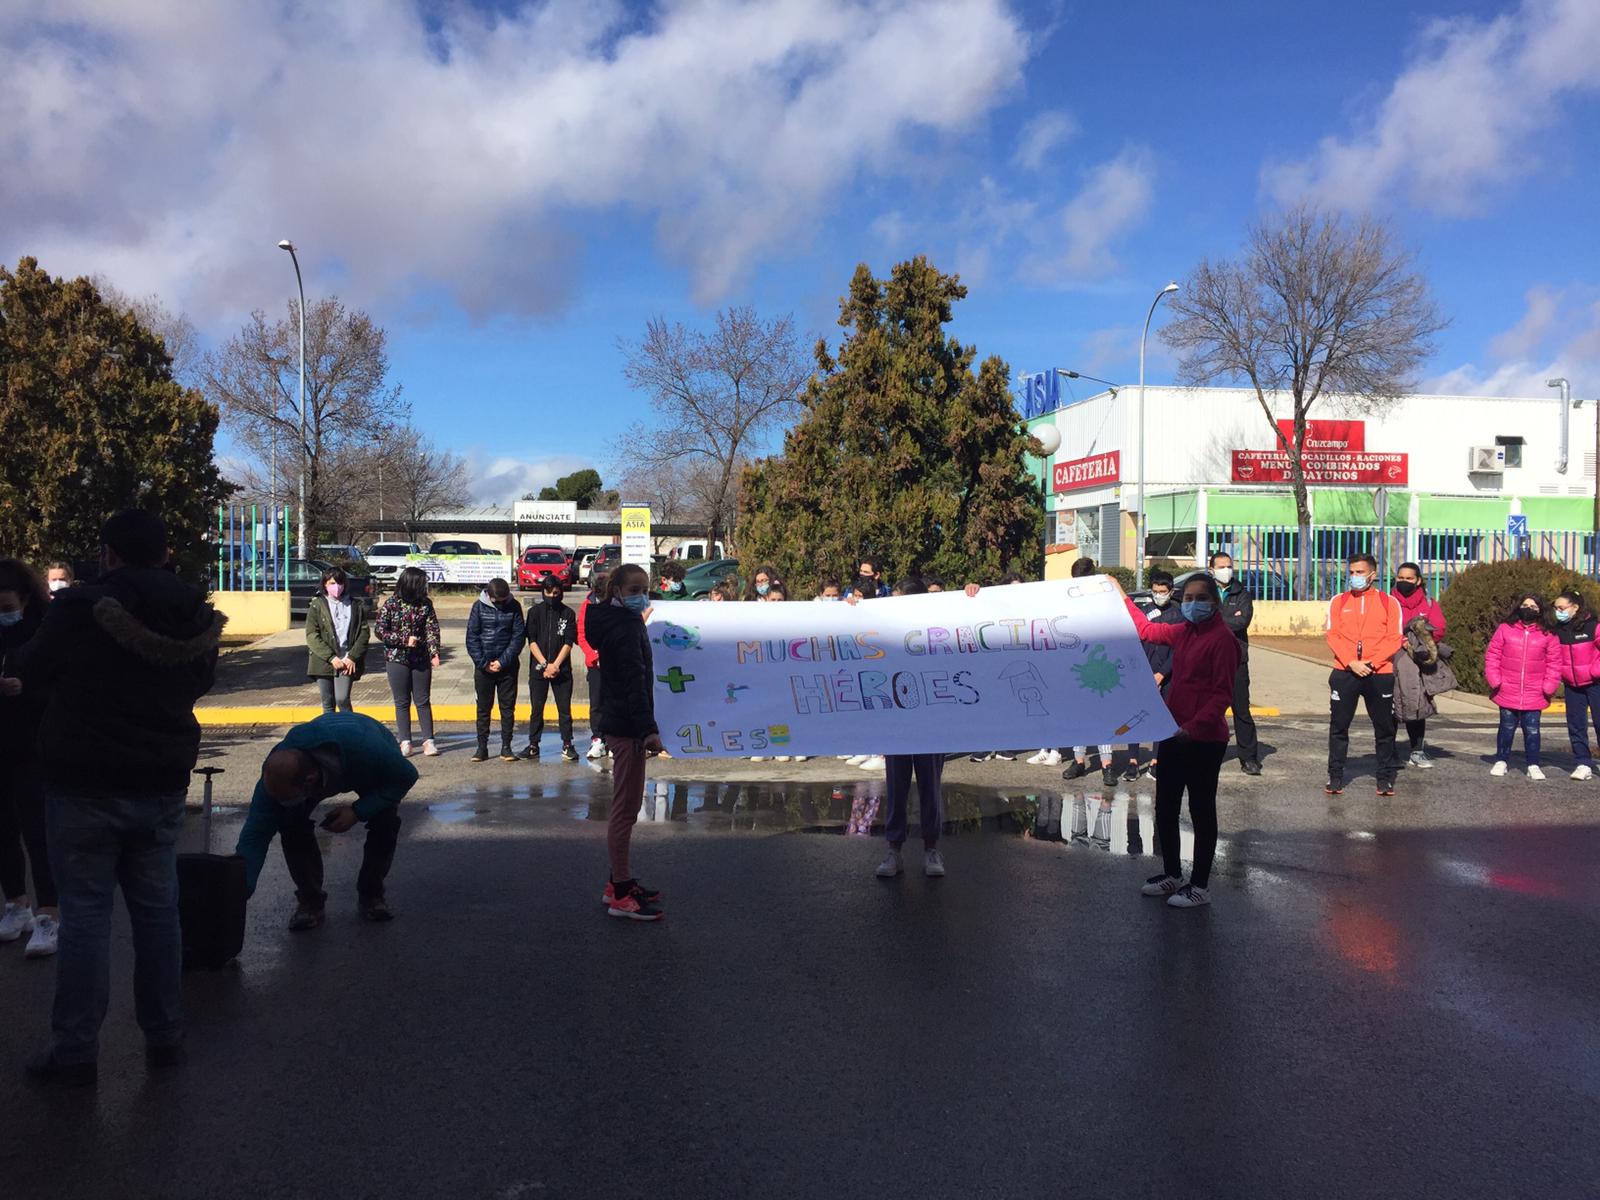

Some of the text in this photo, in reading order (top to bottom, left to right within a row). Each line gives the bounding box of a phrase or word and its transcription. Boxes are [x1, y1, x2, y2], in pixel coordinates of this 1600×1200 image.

[1306, 438, 1348, 450] Cruzcampo
[1055, 453, 1117, 485] CAFETERÍA
[1306, 462, 1380, 471] COMBINADOS
[626, 521, 646, 529] ASIA
[425, 571, 446, 582] SIA
[737, 615, 1089, 664] MUCHAS GRACIAS,
[790, 669, 980, 714] HÉROES
